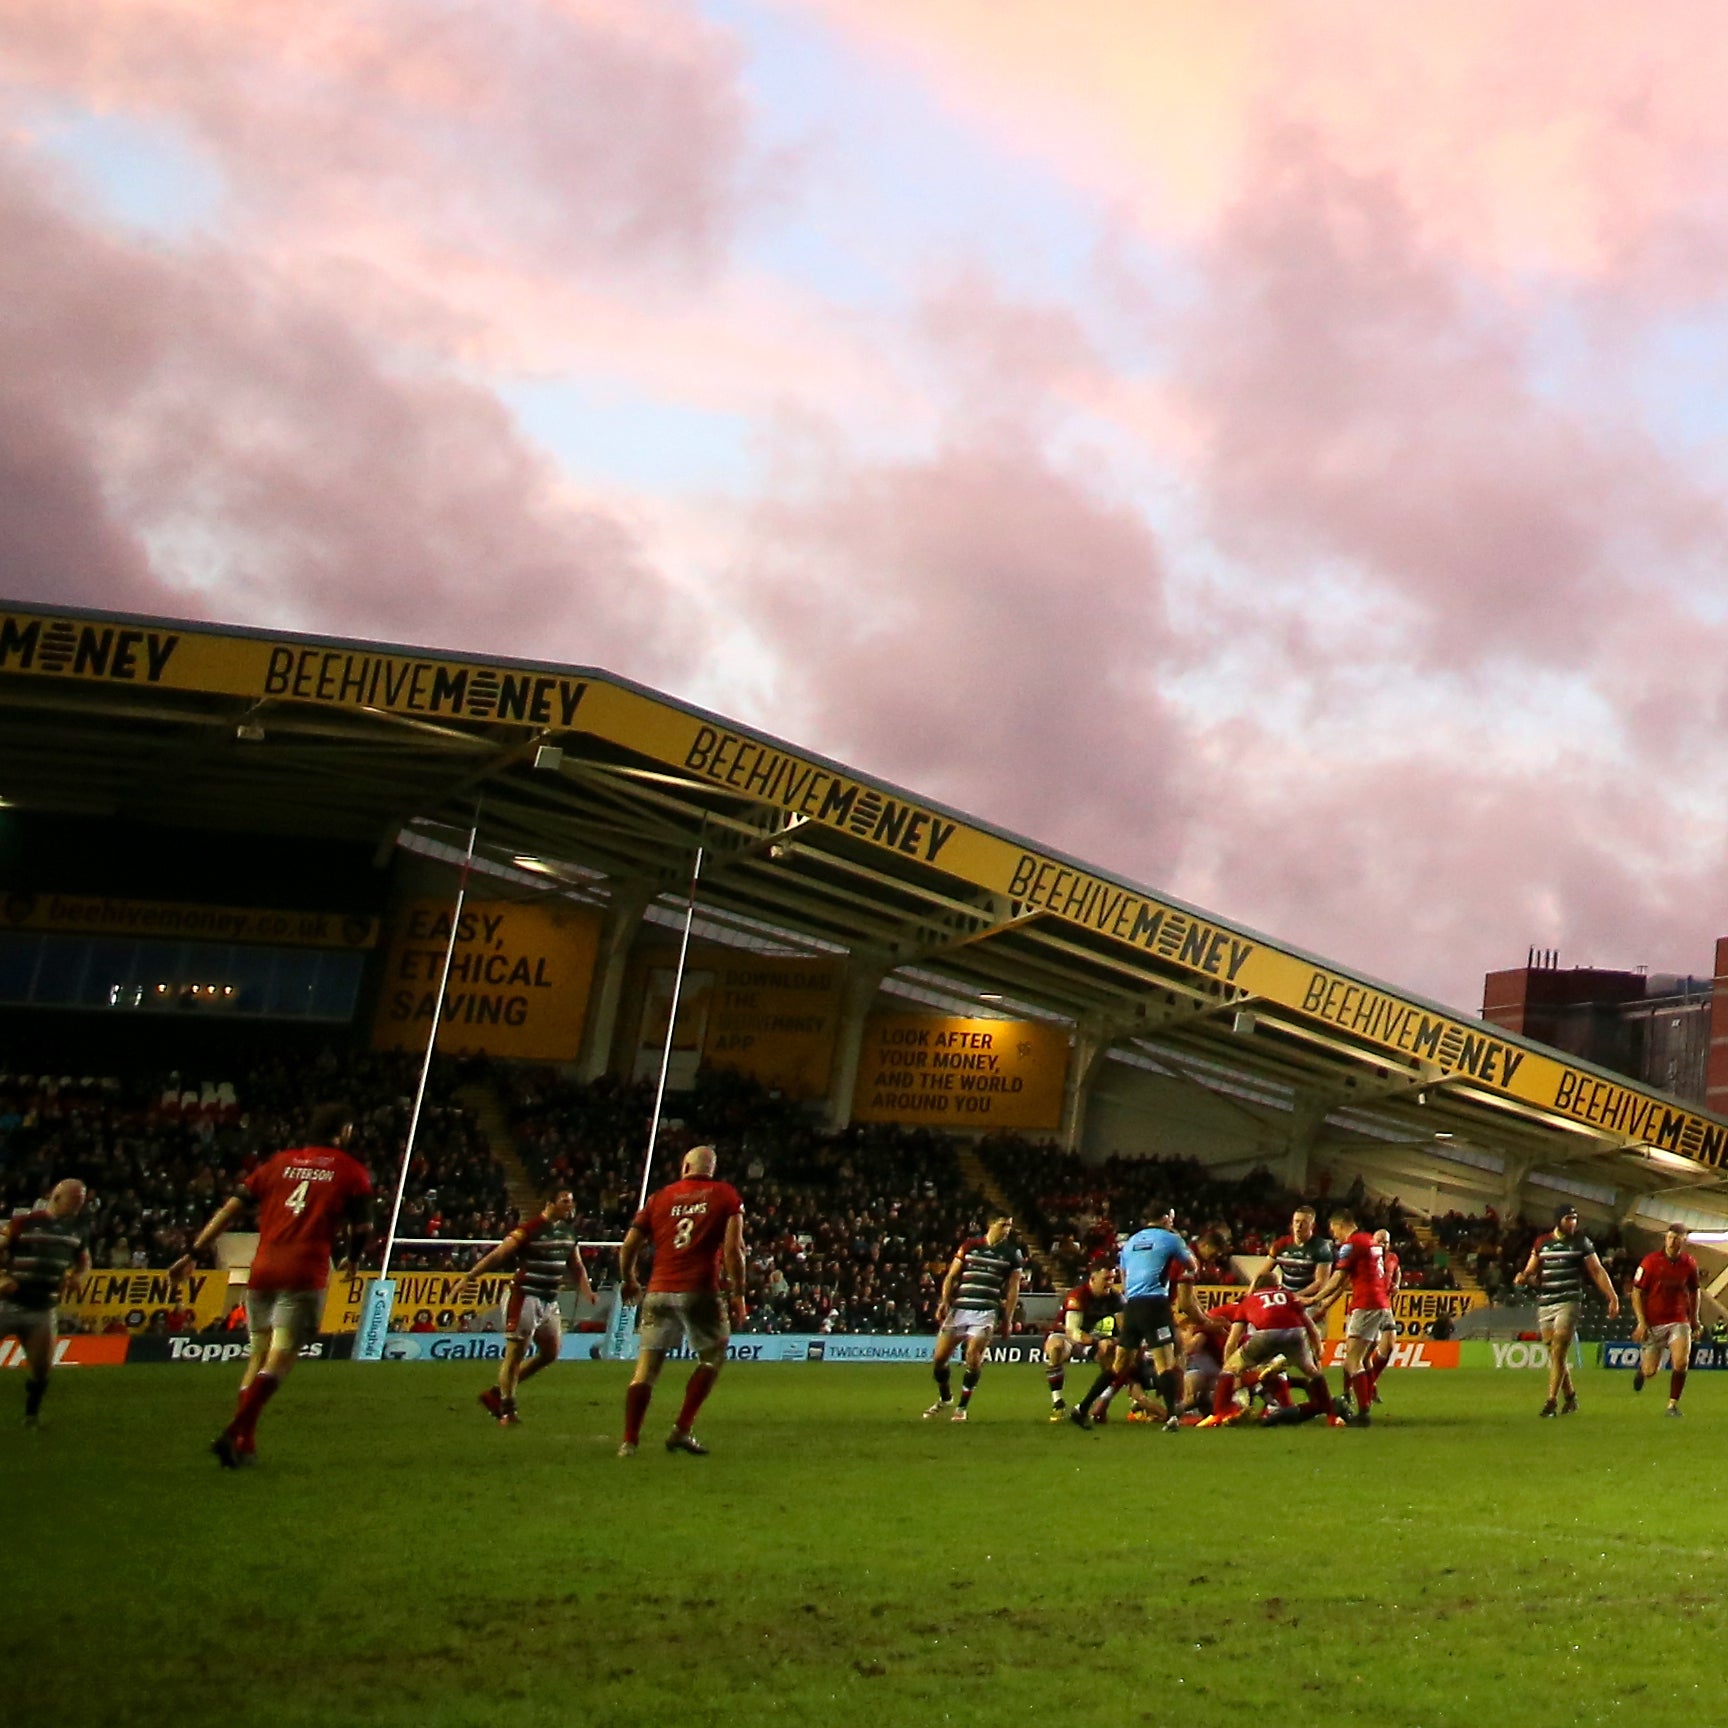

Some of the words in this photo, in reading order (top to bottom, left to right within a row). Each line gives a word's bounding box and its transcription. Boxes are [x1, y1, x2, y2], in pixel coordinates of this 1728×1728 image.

[407, 909, 504, 950] EASY,
[400, 949, 552, 988] ETHICAL
[724, 971, 832, 989] DOWNLOAD
[391, 989, 528, 1026] SAVING
[724, 992, 758, 1009] THE
[714, 1034, 755, 1051] APP
[881, 1028, 930, 1047] LOOK
[935, 1031, 993, 1050] AFTER
[879, 1049, 927, 1068] YOUR
[932, 1052, 1001, 1073] MONEY,
[874, 1071, 914, 1089] AND
[920, 1073, 954, 1090] THE
[960, 1075, 1023, 1093] WORLD
[871, 1092, 949, 1113] AROUND
[955, 1095, 991, 1113] YOU
[284, 1180, 308, 1216] 4
[674, 1217, 694, 1249] 8
[1258, 1292, 1288, 1309] 10
[1491, 1343, 1573, 1369] YOD
